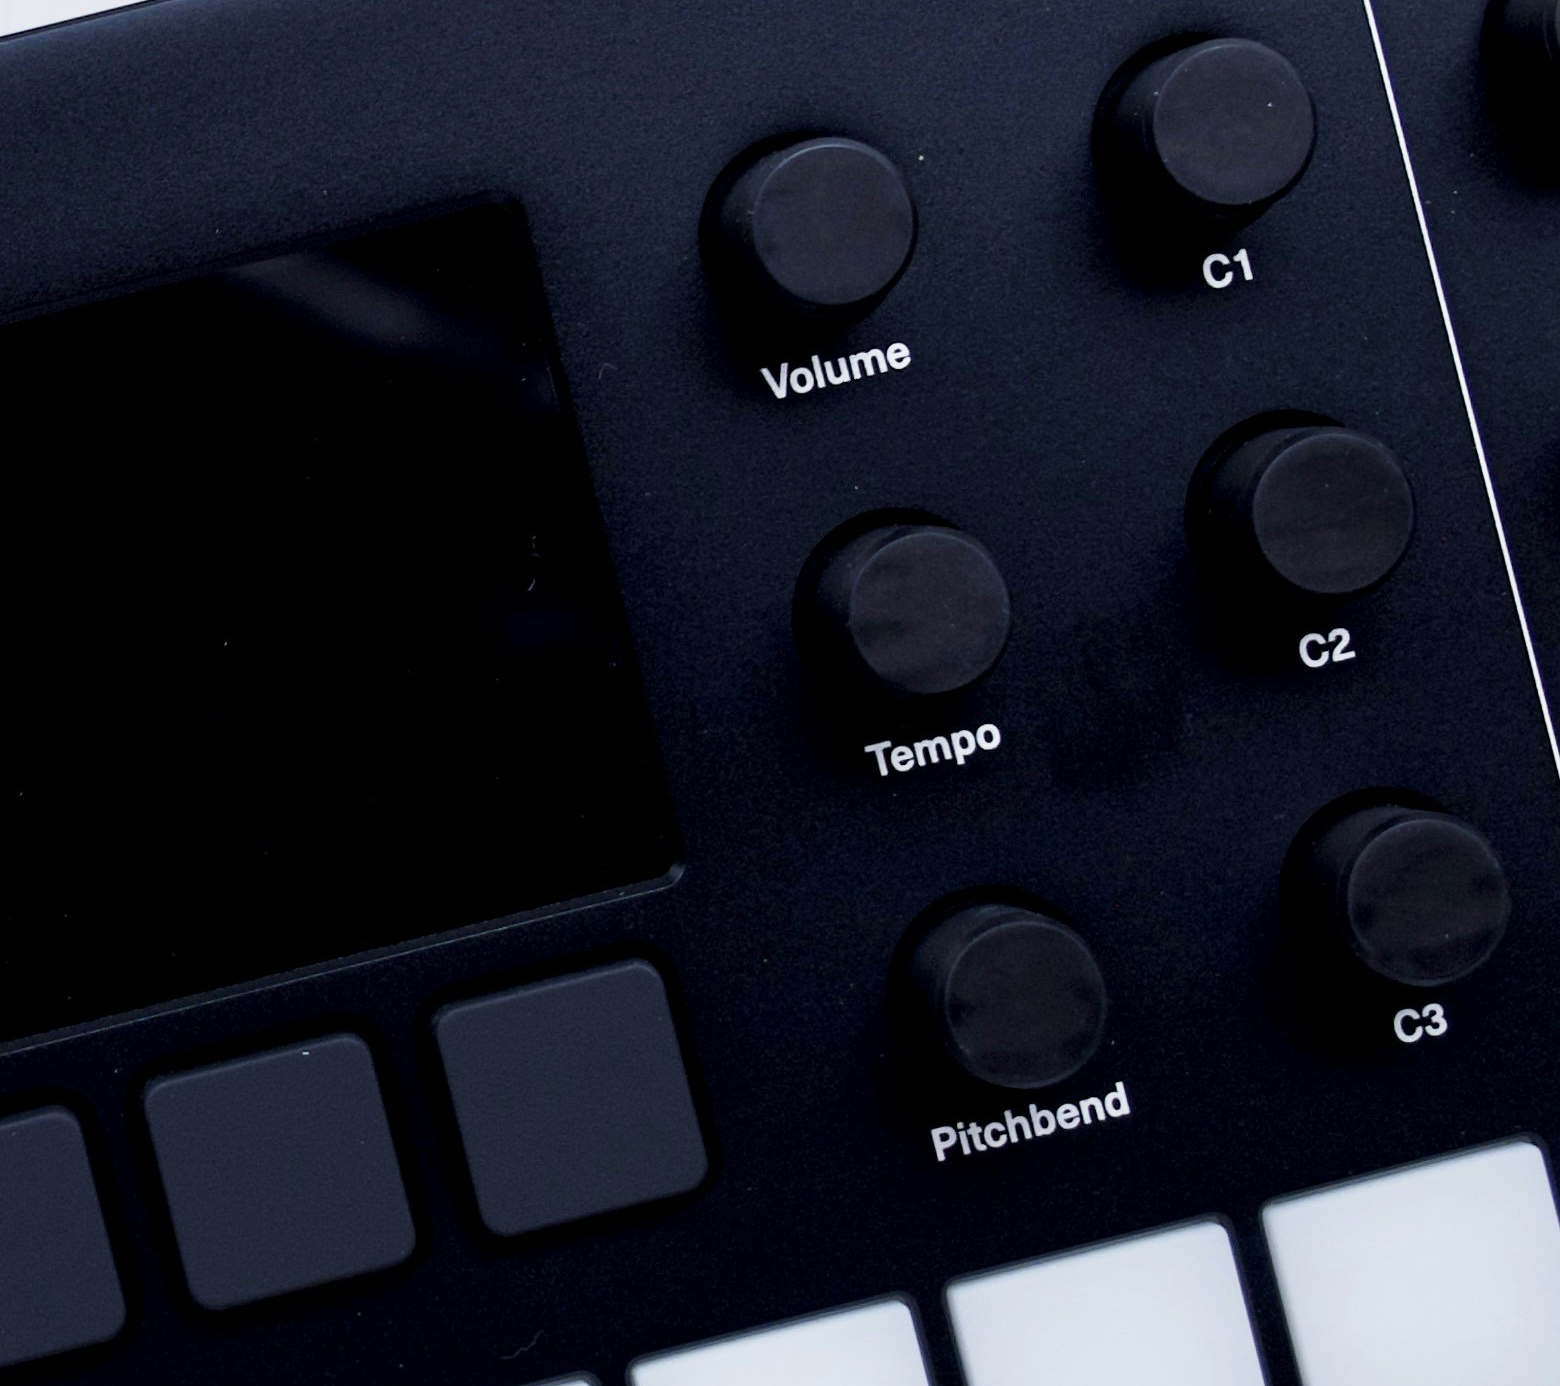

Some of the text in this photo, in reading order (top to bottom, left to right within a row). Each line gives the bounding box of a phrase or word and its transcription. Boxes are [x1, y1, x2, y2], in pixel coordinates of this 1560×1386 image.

[1202, 247, 1254, 289] C1
[760, 341, 912, 399] Volume
[1298, 627, 1356, 668] C2
[863, 722, 1002, 777] Tempo
[1392, 1002, 1449, 1043] C3
[930, 1080, 1131, 1162] Pitchbend
